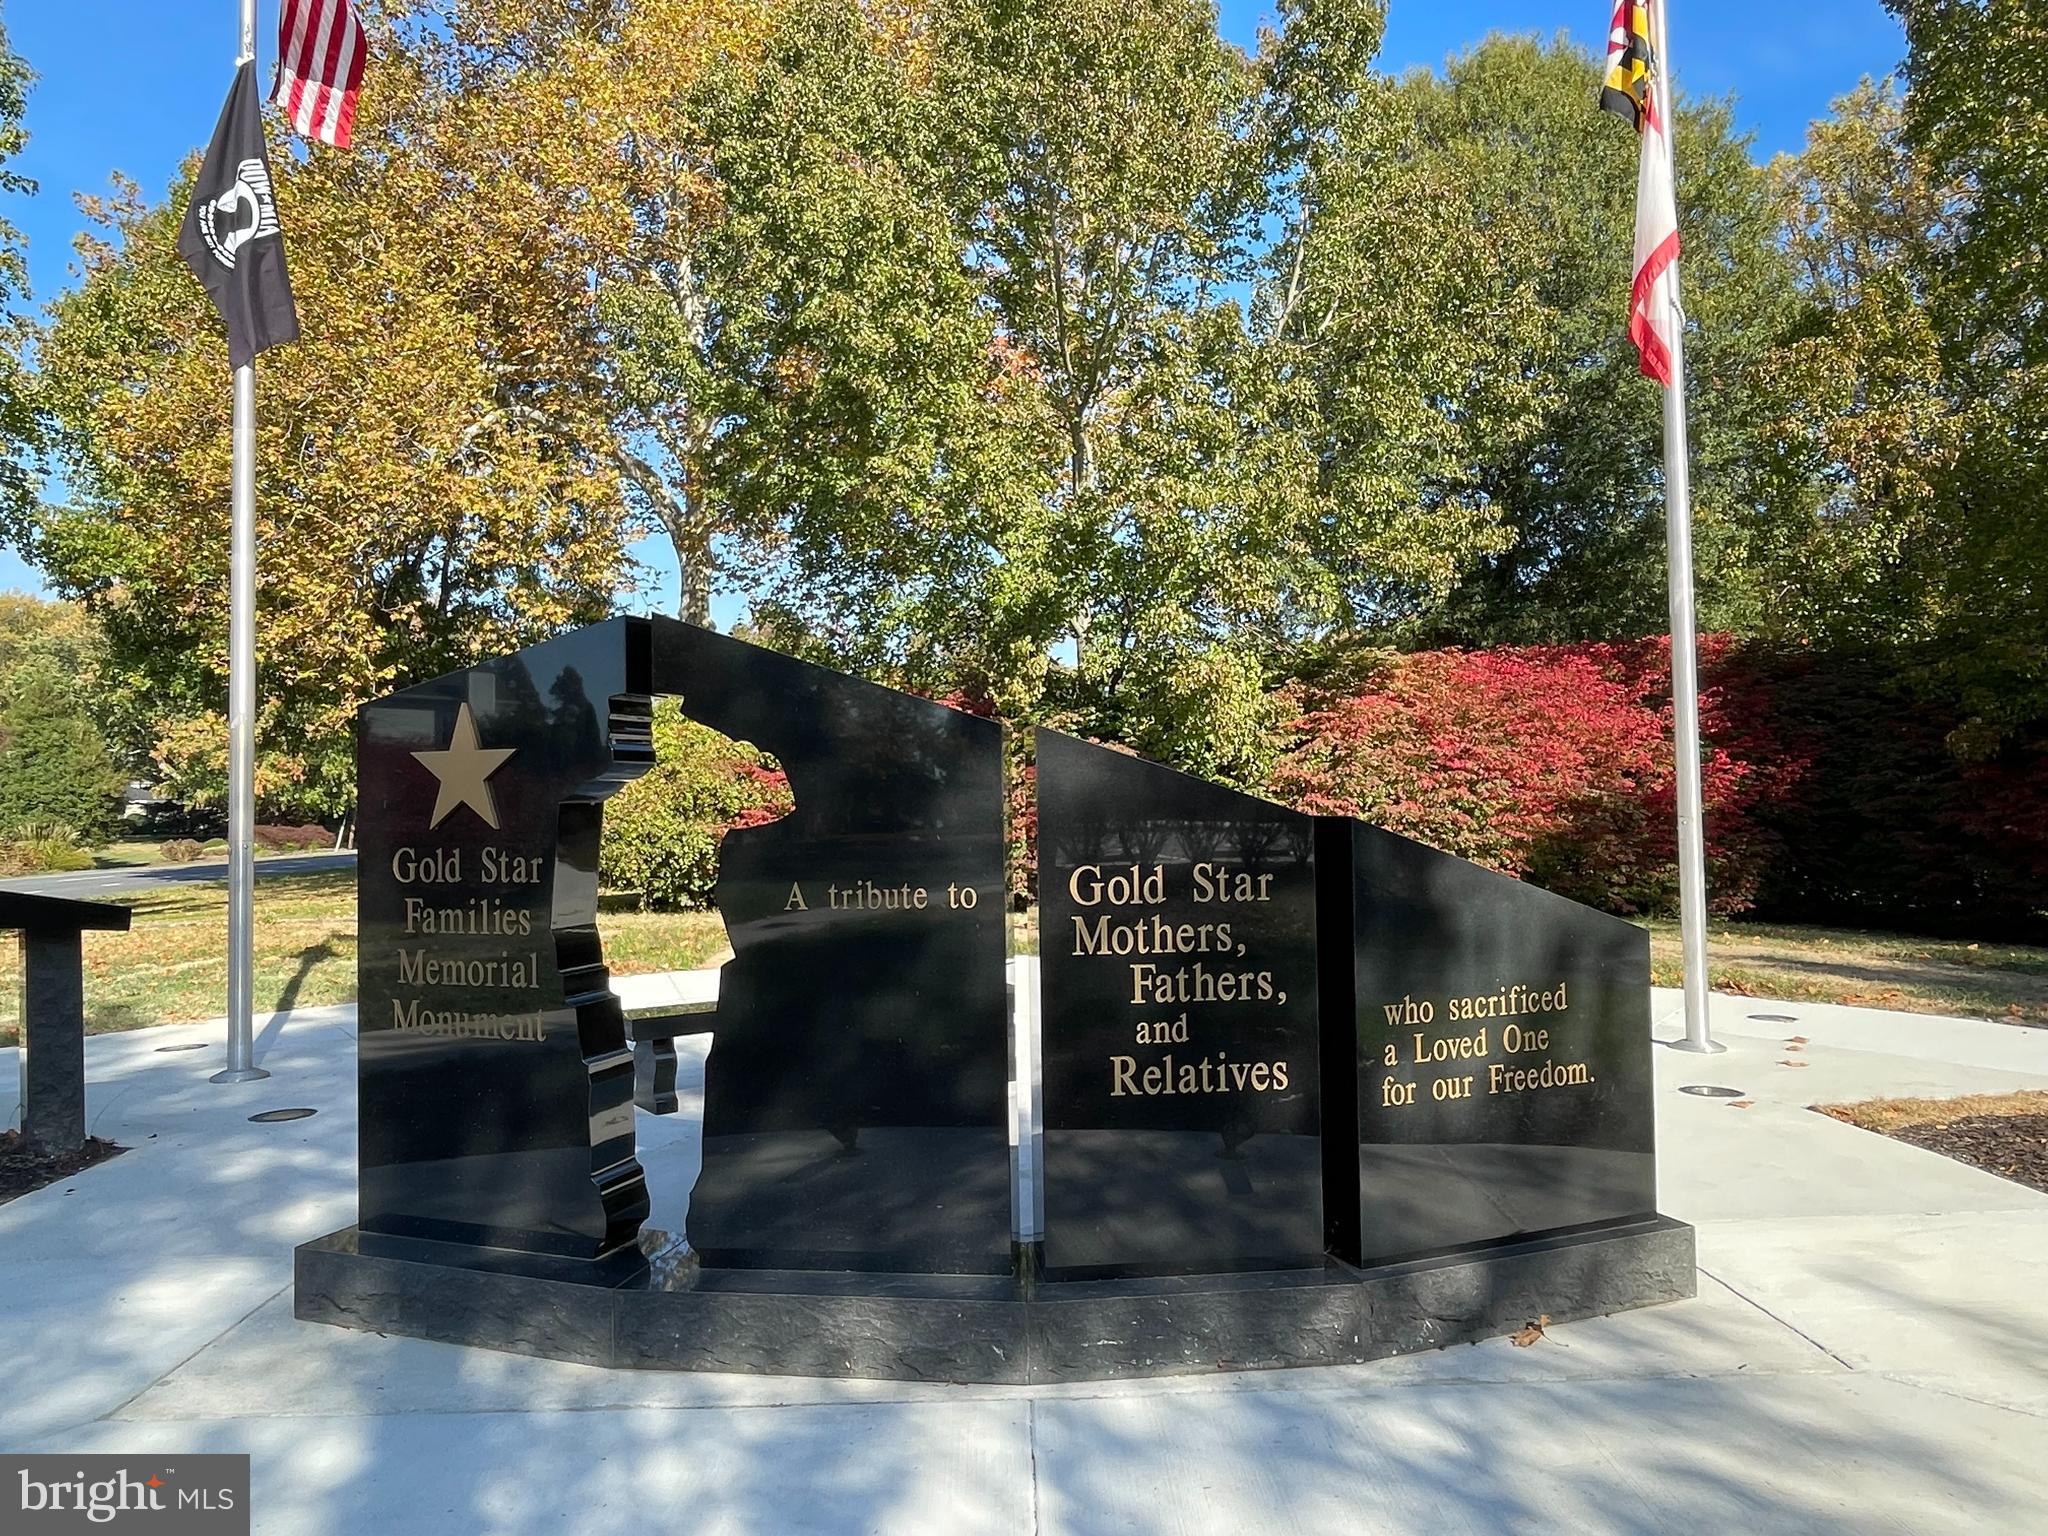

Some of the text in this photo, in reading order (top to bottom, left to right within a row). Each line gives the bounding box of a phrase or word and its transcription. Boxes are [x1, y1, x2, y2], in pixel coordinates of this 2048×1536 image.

[392, 847, 543, 884] Gold Star
[1069, 862, 1274, 906] Gold Star
[404, 898, 532, 936] Families
[783, 880, 978, 911] A tribute to
[1070, 915, 1247, 958] Mothers,
[397, 948, 540, 989] Memorial
[1129, 963, 1288, 1006] Fathers,
[392, 998, 547, 1042] Monument
[1383, 982, 1568, 1026] who sacrificed
[1136, 1013, 1189, 1045] and
[1384, 1024, 1549, 1067] a Loved One
[1110, 1052, 1290, 1097] Relatives
[1382, 1060, 1596, 1107] for our Freedom.
